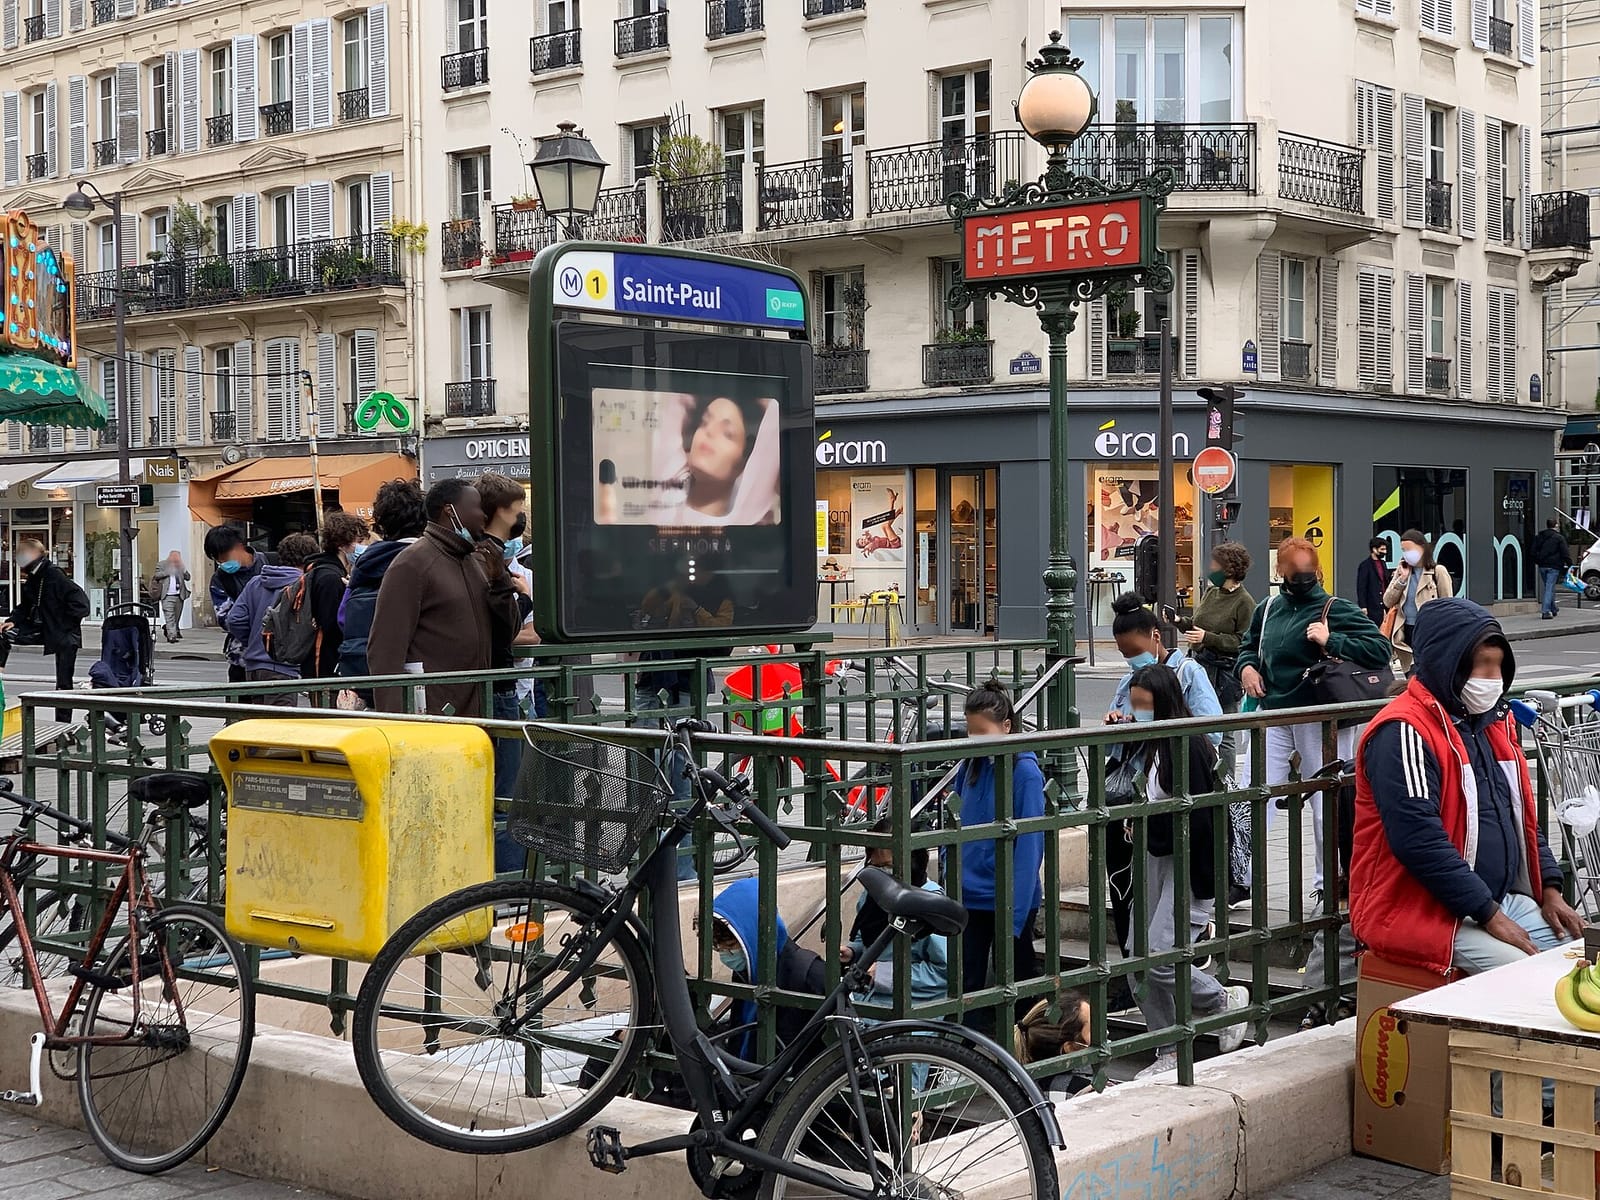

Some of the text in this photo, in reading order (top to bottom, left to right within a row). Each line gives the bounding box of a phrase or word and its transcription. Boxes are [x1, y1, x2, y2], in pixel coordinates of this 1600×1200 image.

[976, 212, 1129, 270] METRO
[592, 276, 600, 294] 1
[622, 276, 721, 309] Saint-Paul
[815, 429, 887, 465] éram
[148, 463, 175, 477] Nails
[1304, 515, 1323, 548] é
